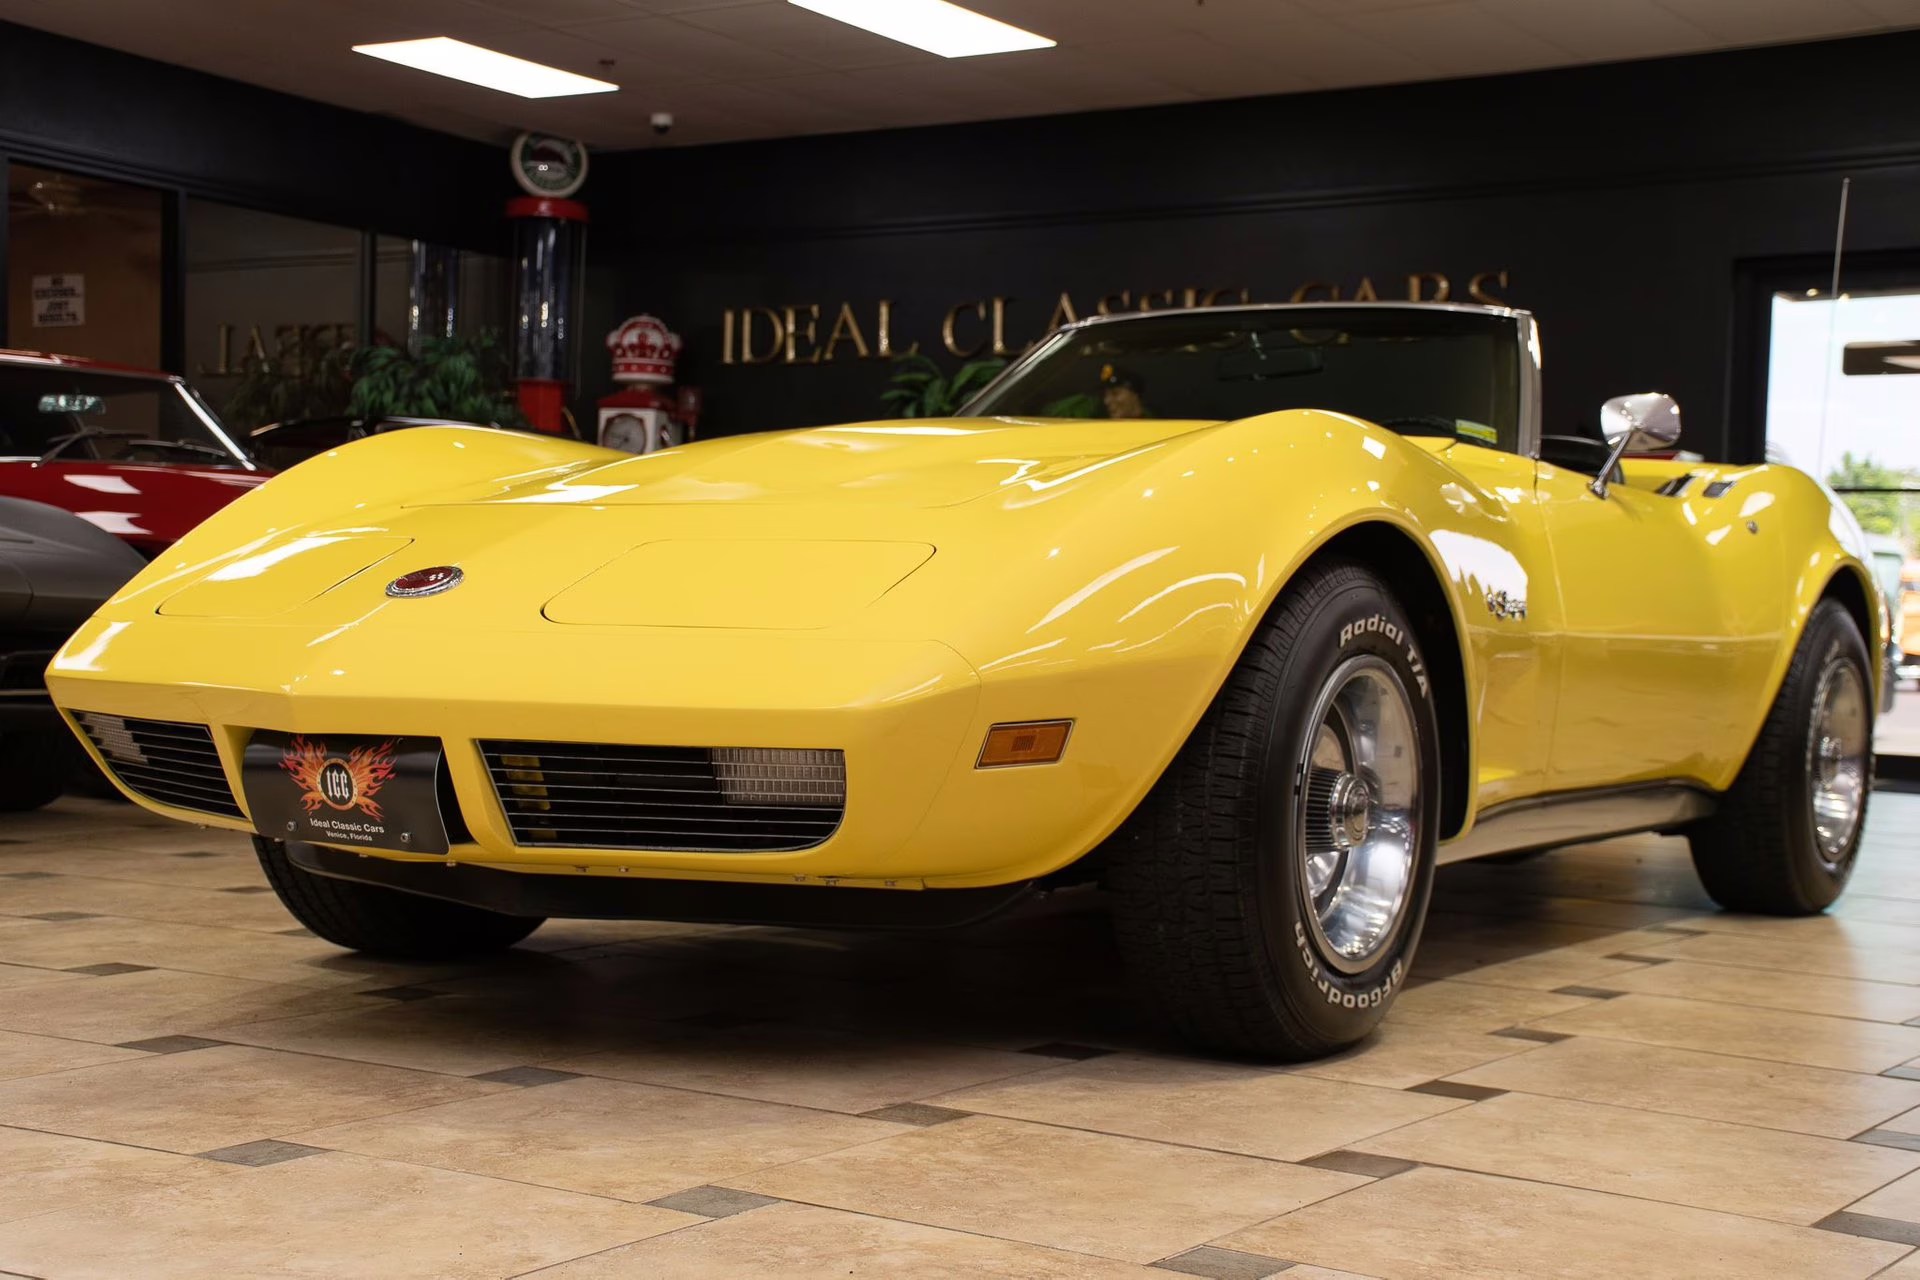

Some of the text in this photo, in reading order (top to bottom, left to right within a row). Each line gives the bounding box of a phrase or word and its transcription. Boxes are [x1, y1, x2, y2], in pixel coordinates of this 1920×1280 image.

[720, 299, 919, 365] IDEAL
[1340, 613, 1404, 648] Radial
[326, 769, 350, 800] ICC
[310, 818, 385, 833] Ideal Classic Cars
[326, 830, 373, 841] Venice, Florida
[1295, 921, 1402, 1008] BFGoodrich
